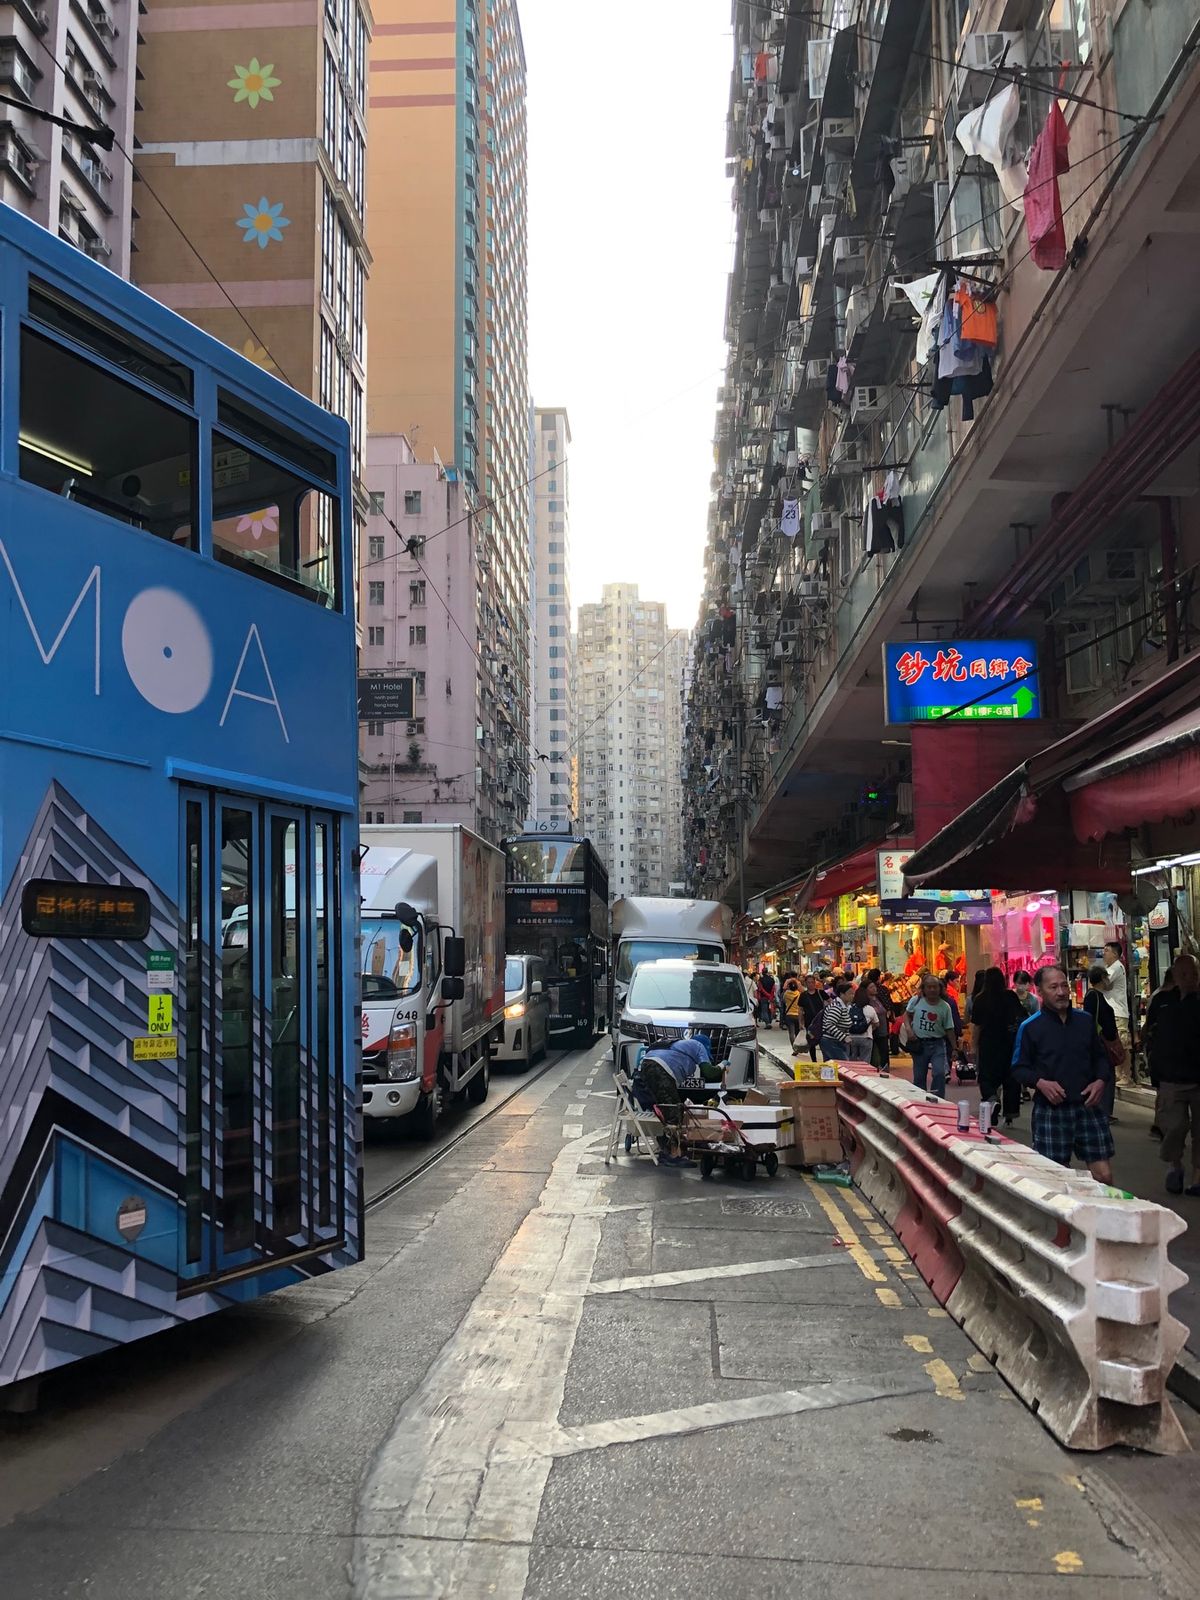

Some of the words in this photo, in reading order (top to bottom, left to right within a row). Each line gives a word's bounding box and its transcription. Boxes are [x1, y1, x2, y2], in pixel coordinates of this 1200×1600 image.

[785, 510, 796, 520] 23
[535, 821, 559, 831] 169
[157, 996, 165, 1010] 上
[156, 1012, 165, 1022] IN
[396, 1010, 418, 1020] 648
[920, 1009, 928, 1020] I
[151, 1022, 170, 1032] ONLY
[577, 1018, 588, 1026] 169
[920, 1020, 935, 1031] HK
